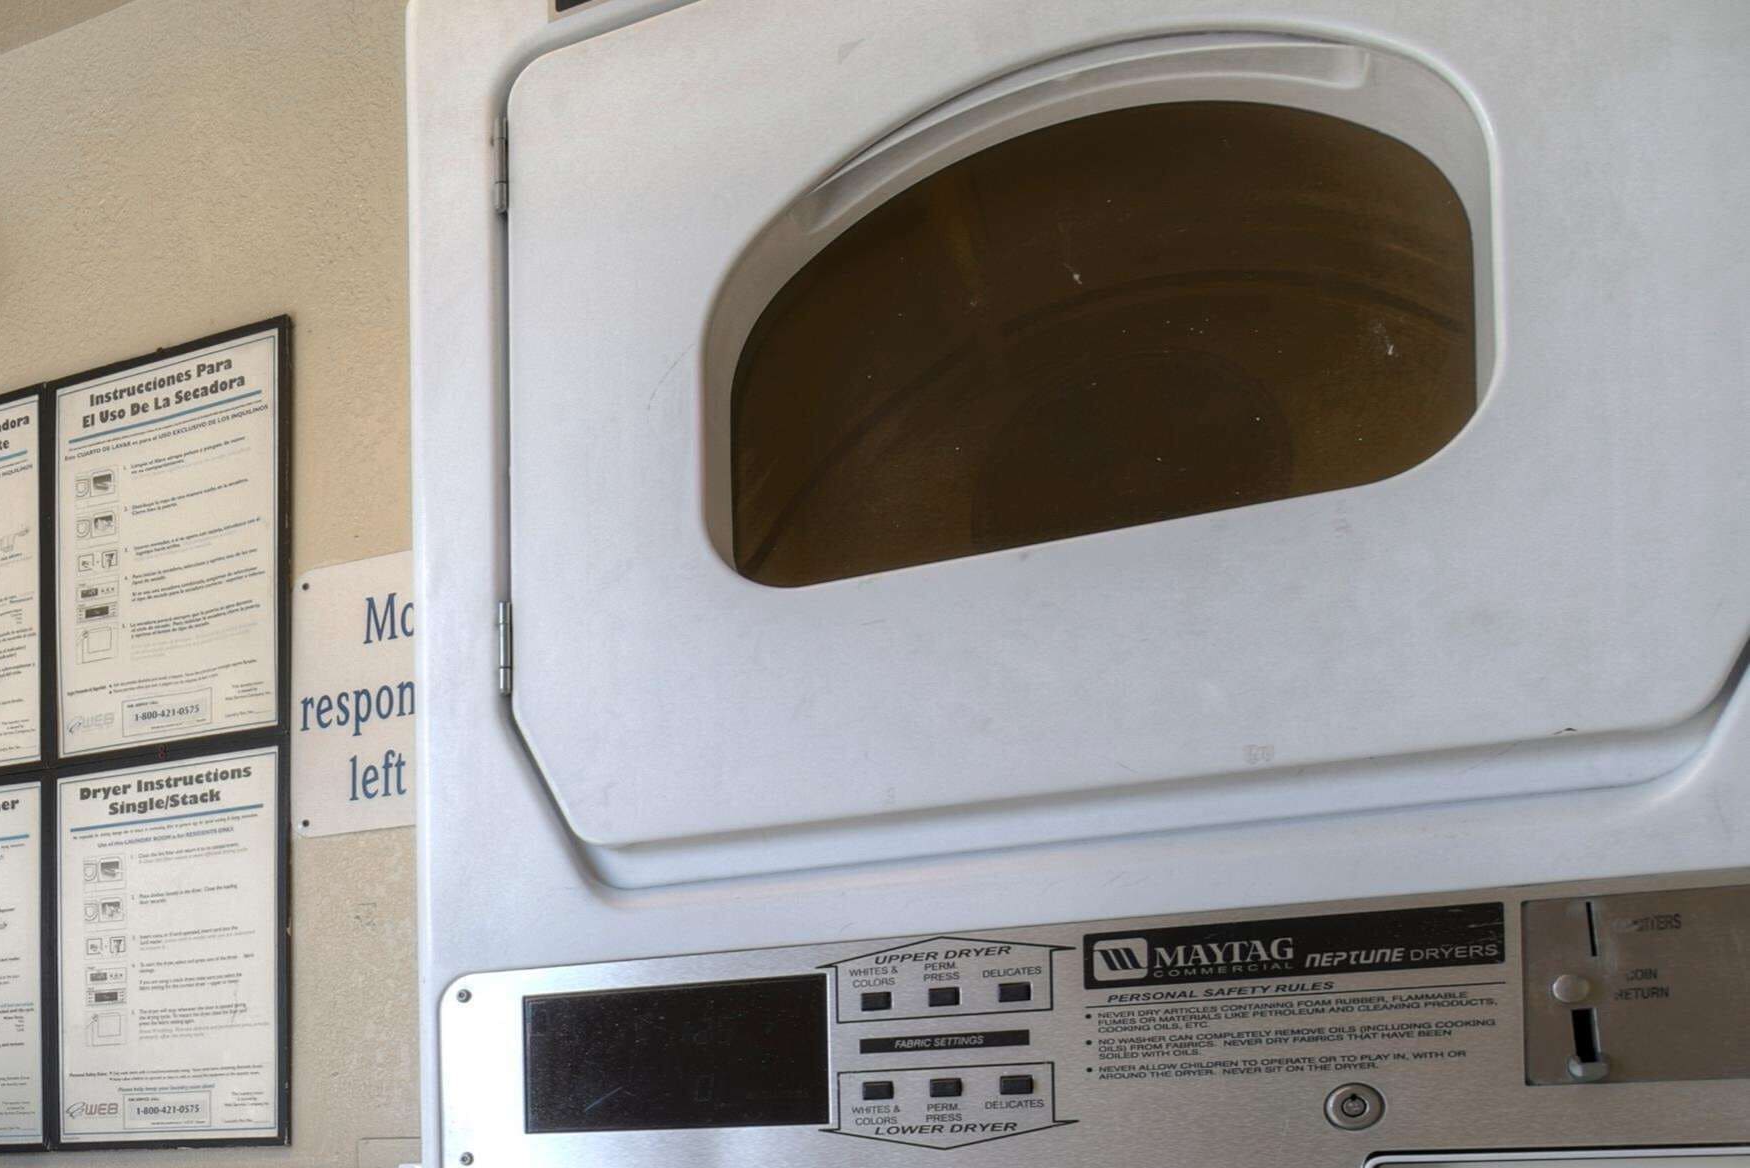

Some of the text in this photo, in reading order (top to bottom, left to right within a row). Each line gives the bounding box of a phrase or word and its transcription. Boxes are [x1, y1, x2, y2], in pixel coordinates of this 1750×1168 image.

[90, 359, 233, 407] Instrucciones Para
[82, 376, 245, 428] El Uso De La Secadora
[135, 704, 200, 721] 1-800-421-0575
[349, 749, 407, 801] left
[79, 766, 252, 802] Dryer Instructions
[109, 789, 221, 816] Single/Stack
[875, 946, 1012, 965] UPPER DRYER
[1154, 937, 1294, 968] MAYTAG
[1305, 944, 1499, 968] NEPTUNE DRYERS
[849, 966, 898, 977] WHITES &
[923, 972, 960, 982] PRESS
[982, 966, 1042, 979] DELICATES
[1154, 962, 1295, 978] COMMERCIAL
[853, 977, 895, 988] COLORS
[1107, 981, 1335, 1003] PERSONAL SAFETY RULES
[1098, 1011, 1134, 1019] NEVER
[1138, 1009, 1161, 1017] DRY
[1168, 1006, 1217, 1015] ARTICLES
[1220, 1001, 1294, 1012] CONTAINING
[1298, 1000, 1331, 1008] FOAM
[1392, 992, 1467, 1001] FLAMMABLE
[1098, 1018, 1137, 1026] FUMES
[1159, 1013, 1221, 1022] MATERIALS
[1224, 1011, 1250, 1019] LIKE
[1253, 1007, 1325, 1017] PETROLEUM
[1357, 1002, 1420, 1012] CLEANING
[1424, 998, 1498, 1008] PRODUCTS,
[1098, 1025, 1151, 1033] COOKING
[1117, 1035, 1166, 1044] WASHER
[1196, 1030, 1272, 1040] COMPLETELY
[1275, 1027, 1324, 1036] REMOVE
[1329, 1026, 1356, 1034] OILS
[1360, 1022, 1432, 1032] (INCLUDING
[1435, 1019, 1496, 1028] COOKING
[1293, 1034, 1343, 1043] FABRICS
[1348, 1032, 1378, 1040] THAT
[1381, 1031, 1414, 1039] HAVE
[895, 1035, 984, 1049] FABRIC SETTINGS
[1099, 1064, 1136, 1073] NEVER
[1139, 1063, 1177, 1071] ALLOW
[1180, 1060, 1239, 1069] CHILDREN
[1261, 1056, 1315, 1065] OPERATE
[1319, 1055, 1337, 1063] OR
[1341, 1055, 1358, 1063] TO
[1361, 1053, 1390, 1061] PLAY
[1413, 1051, 1444, 1059] WITH
[1447, 1050, 1466, 1058] OR
[1099, 1072, 1147, 1080] AROUND
[1286, 1064, 1305, 1072] ON
[1307, 1063, 1331, 1071] THE
[136, 1104, 199, 1115] 1-800-421-0575
[852, 1104, 901, 1114] WHITES &
[985, 1100, 1044, 1110] DELICATES
[855, 1116, 897, 1125] COLORS
[925, 1113, 962, 1122] PRESS
[874, 1122, 1018, 1136] LOWER DRYER
